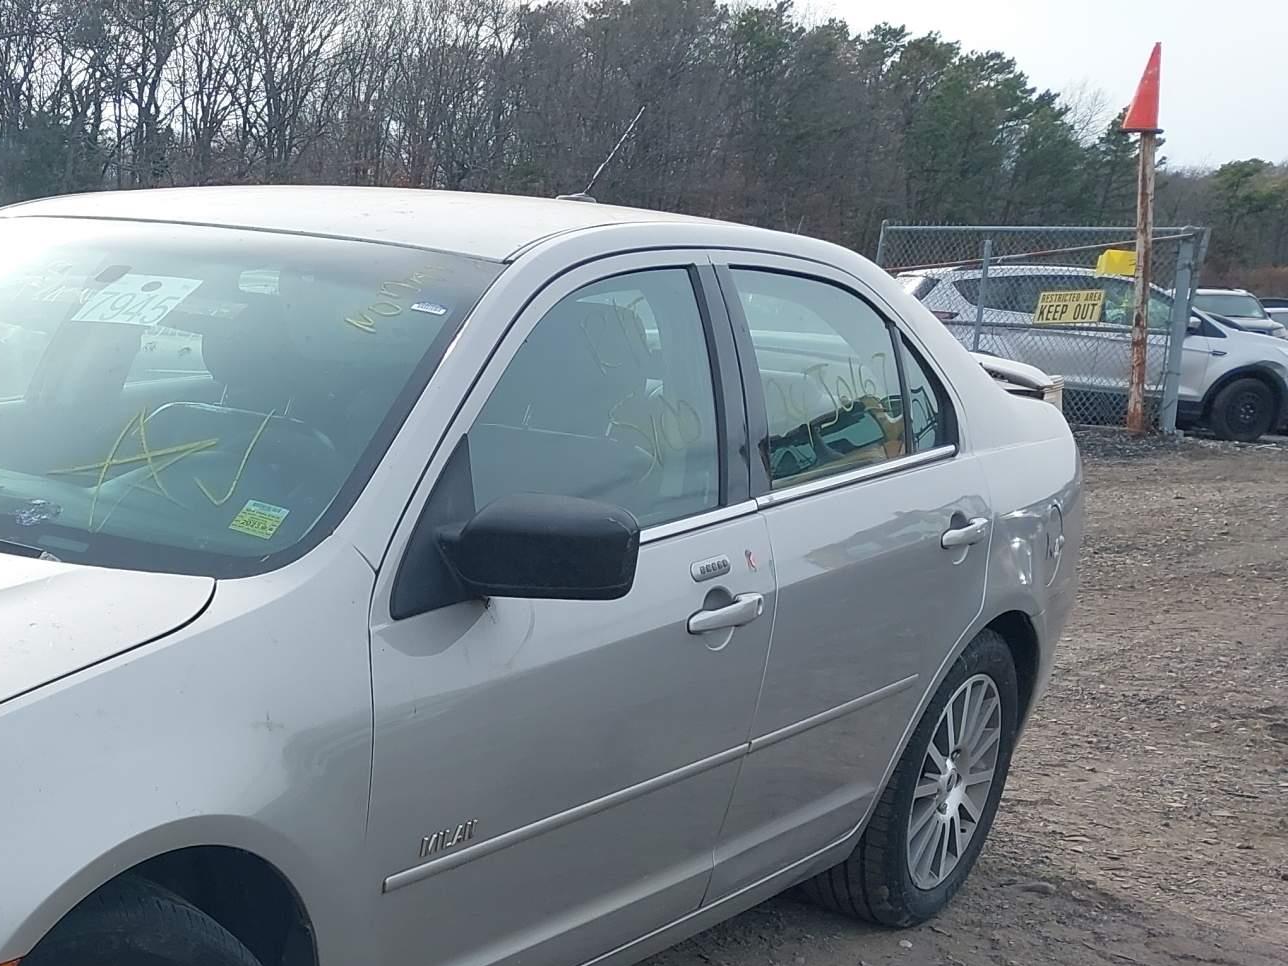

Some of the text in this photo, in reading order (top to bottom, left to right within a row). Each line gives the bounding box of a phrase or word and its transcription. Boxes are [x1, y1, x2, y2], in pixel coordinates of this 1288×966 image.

[1041, 291, 1101, 303] RESTRICTED AREA
[78, 291, 180, 324] 7945
[1037, 303, 1098, 320] KEEP OUT
